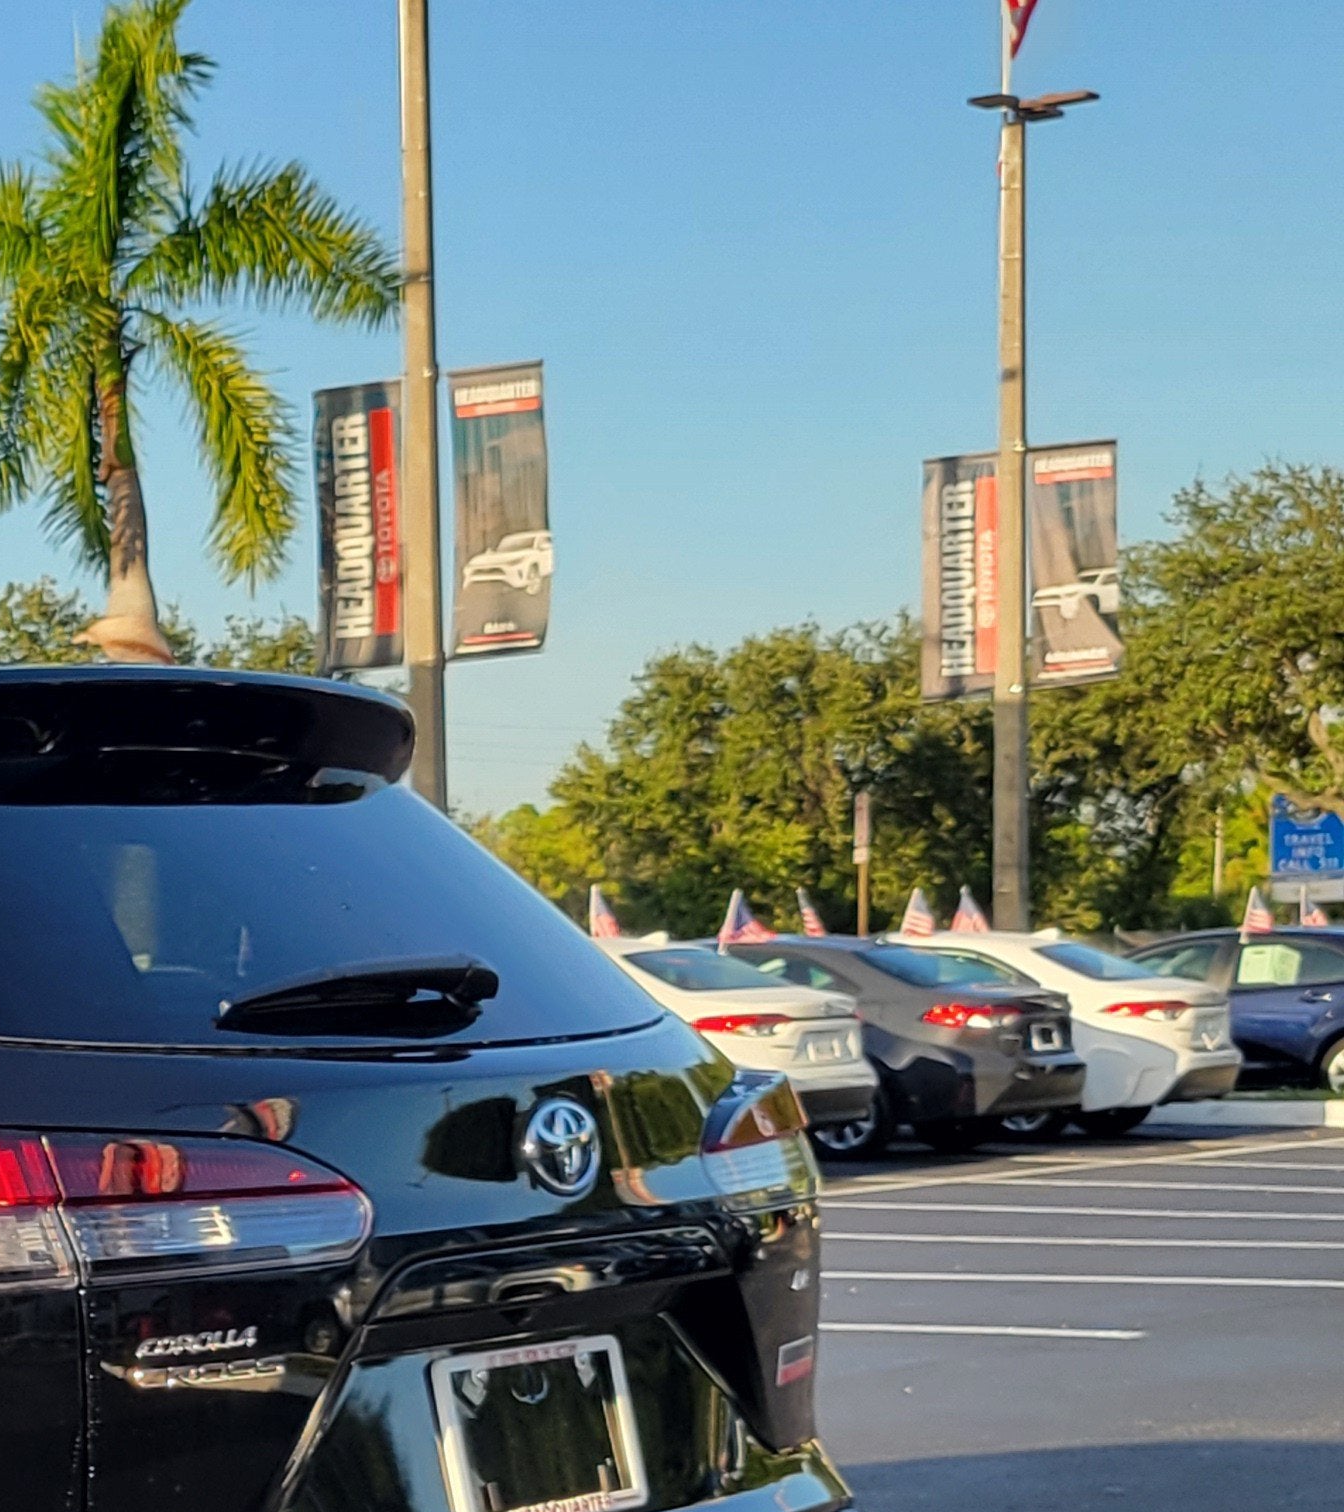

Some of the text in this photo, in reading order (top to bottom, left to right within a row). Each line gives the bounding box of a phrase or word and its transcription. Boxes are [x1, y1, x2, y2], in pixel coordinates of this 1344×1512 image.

[332, 411, 373, 639] HEADQUARTER
[375, 470, 395, 553] TOYOTA
[940, 479, 974, 677] HEADQUARTER
[136, 1325, 259, 1359] COROLLA
